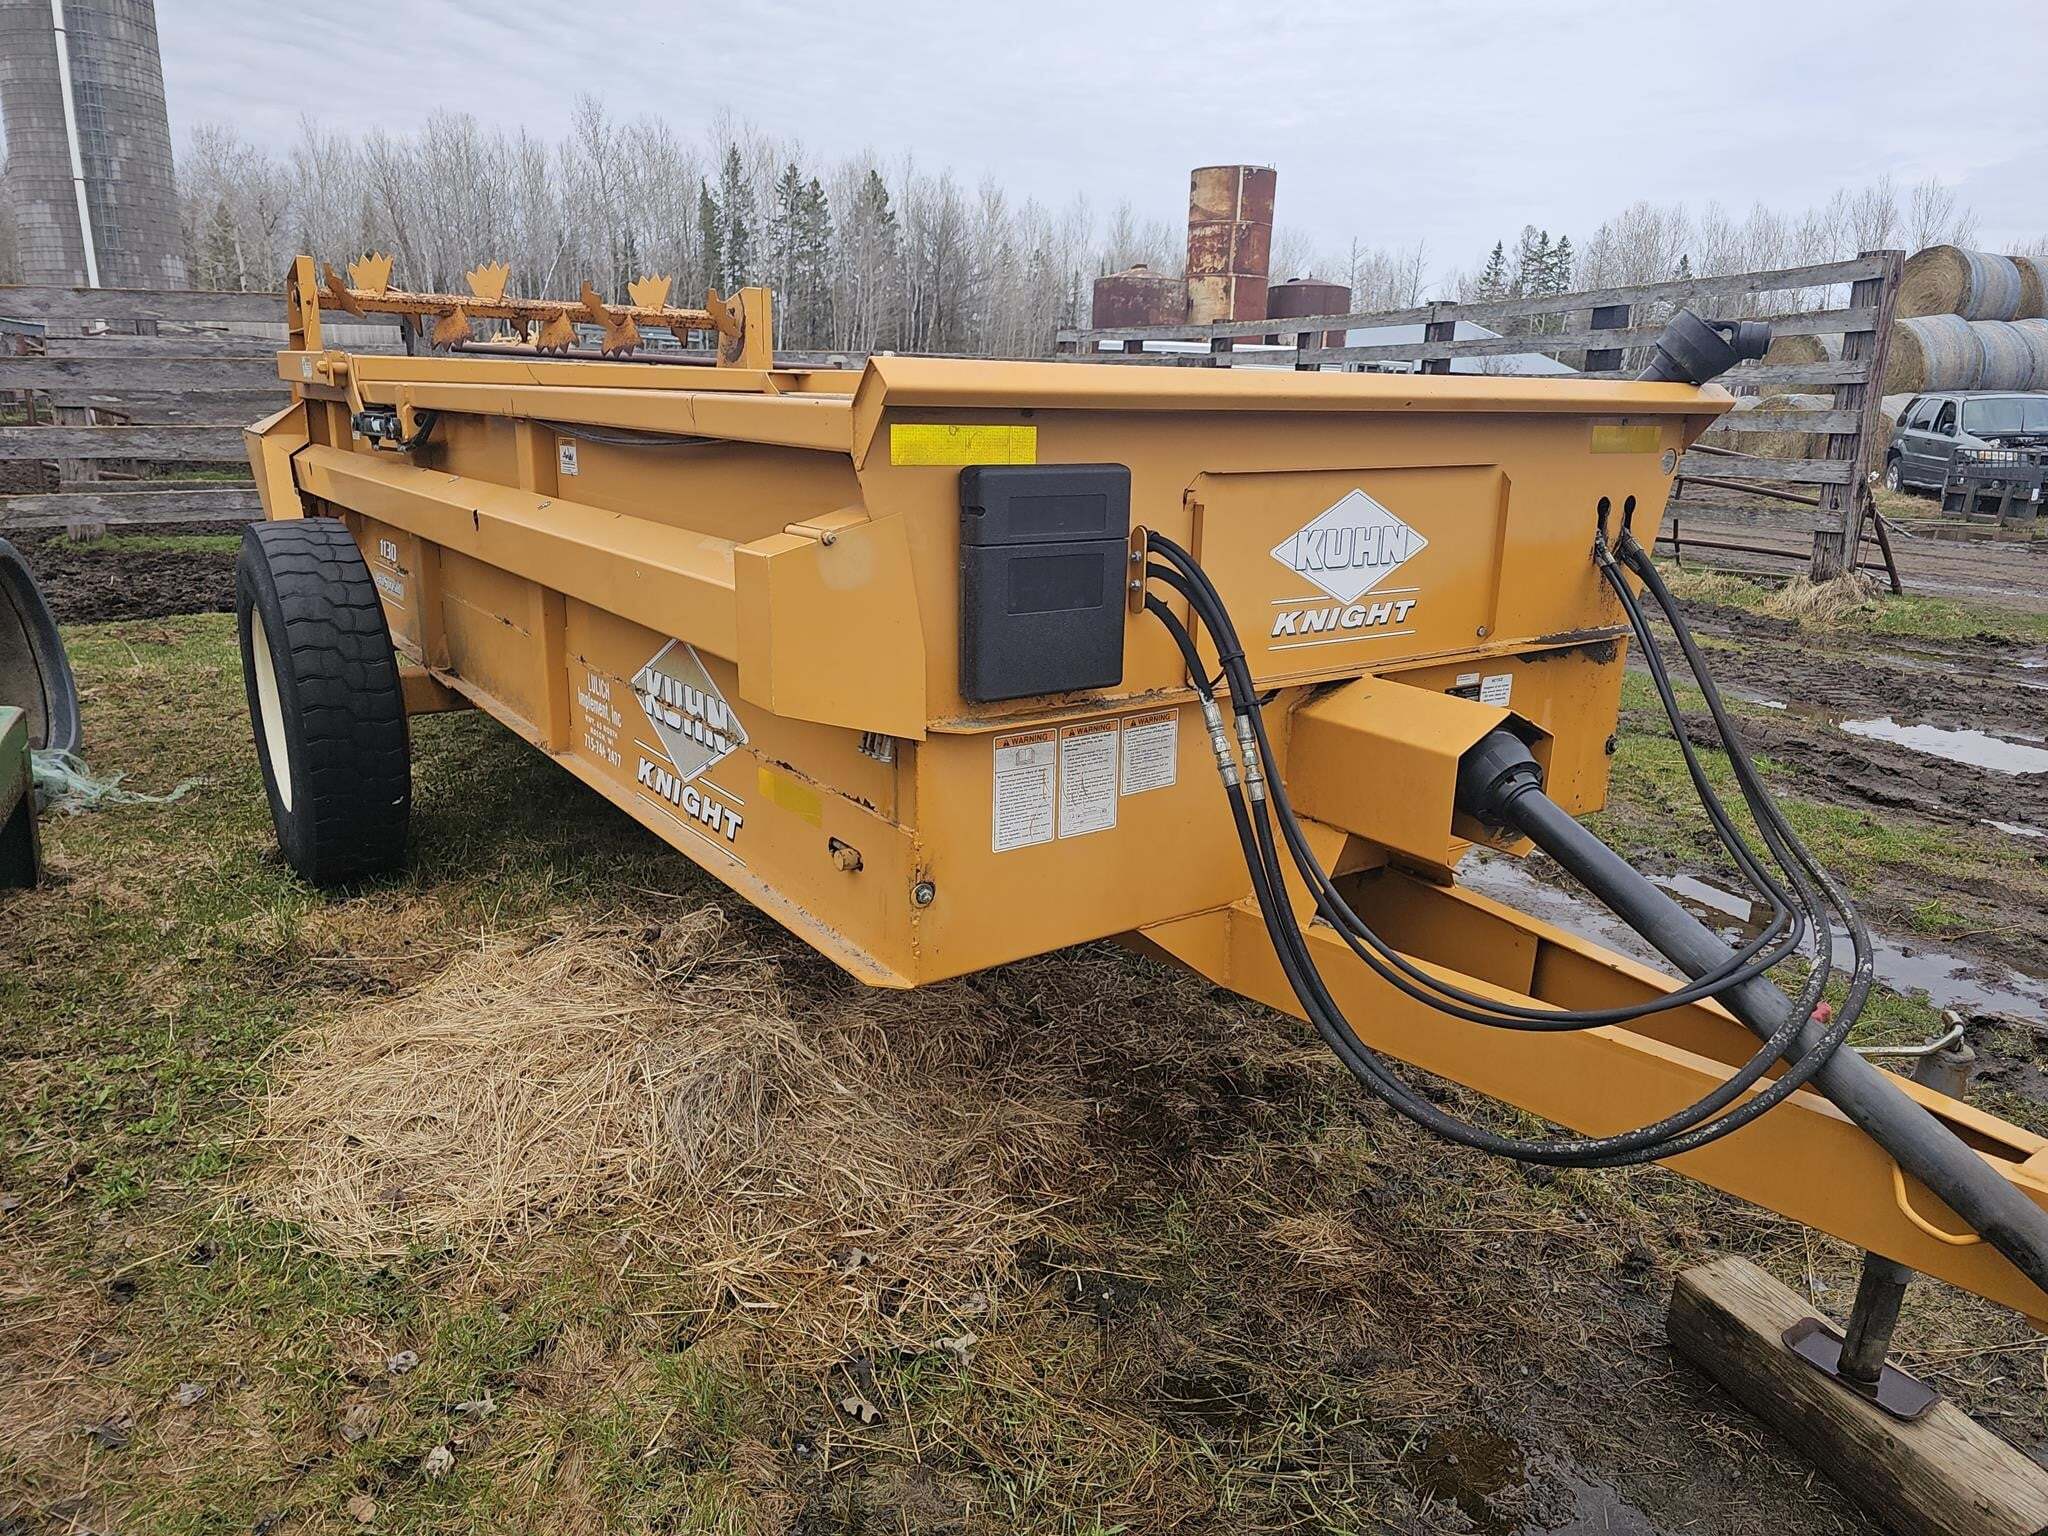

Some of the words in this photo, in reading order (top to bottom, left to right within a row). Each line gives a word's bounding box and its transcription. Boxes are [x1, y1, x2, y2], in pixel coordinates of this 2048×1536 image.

[1295, 525, 1408, 571] KUHN
[1271, 600, 1417, 638] KNIGHT
[1077, 723, 1111, 735] WARNING
[1138, 713, 1171, 725] WARNING
[1012, 733, 1048, 745] WARNING
[637, 756, 743, 841] KNIGHT
